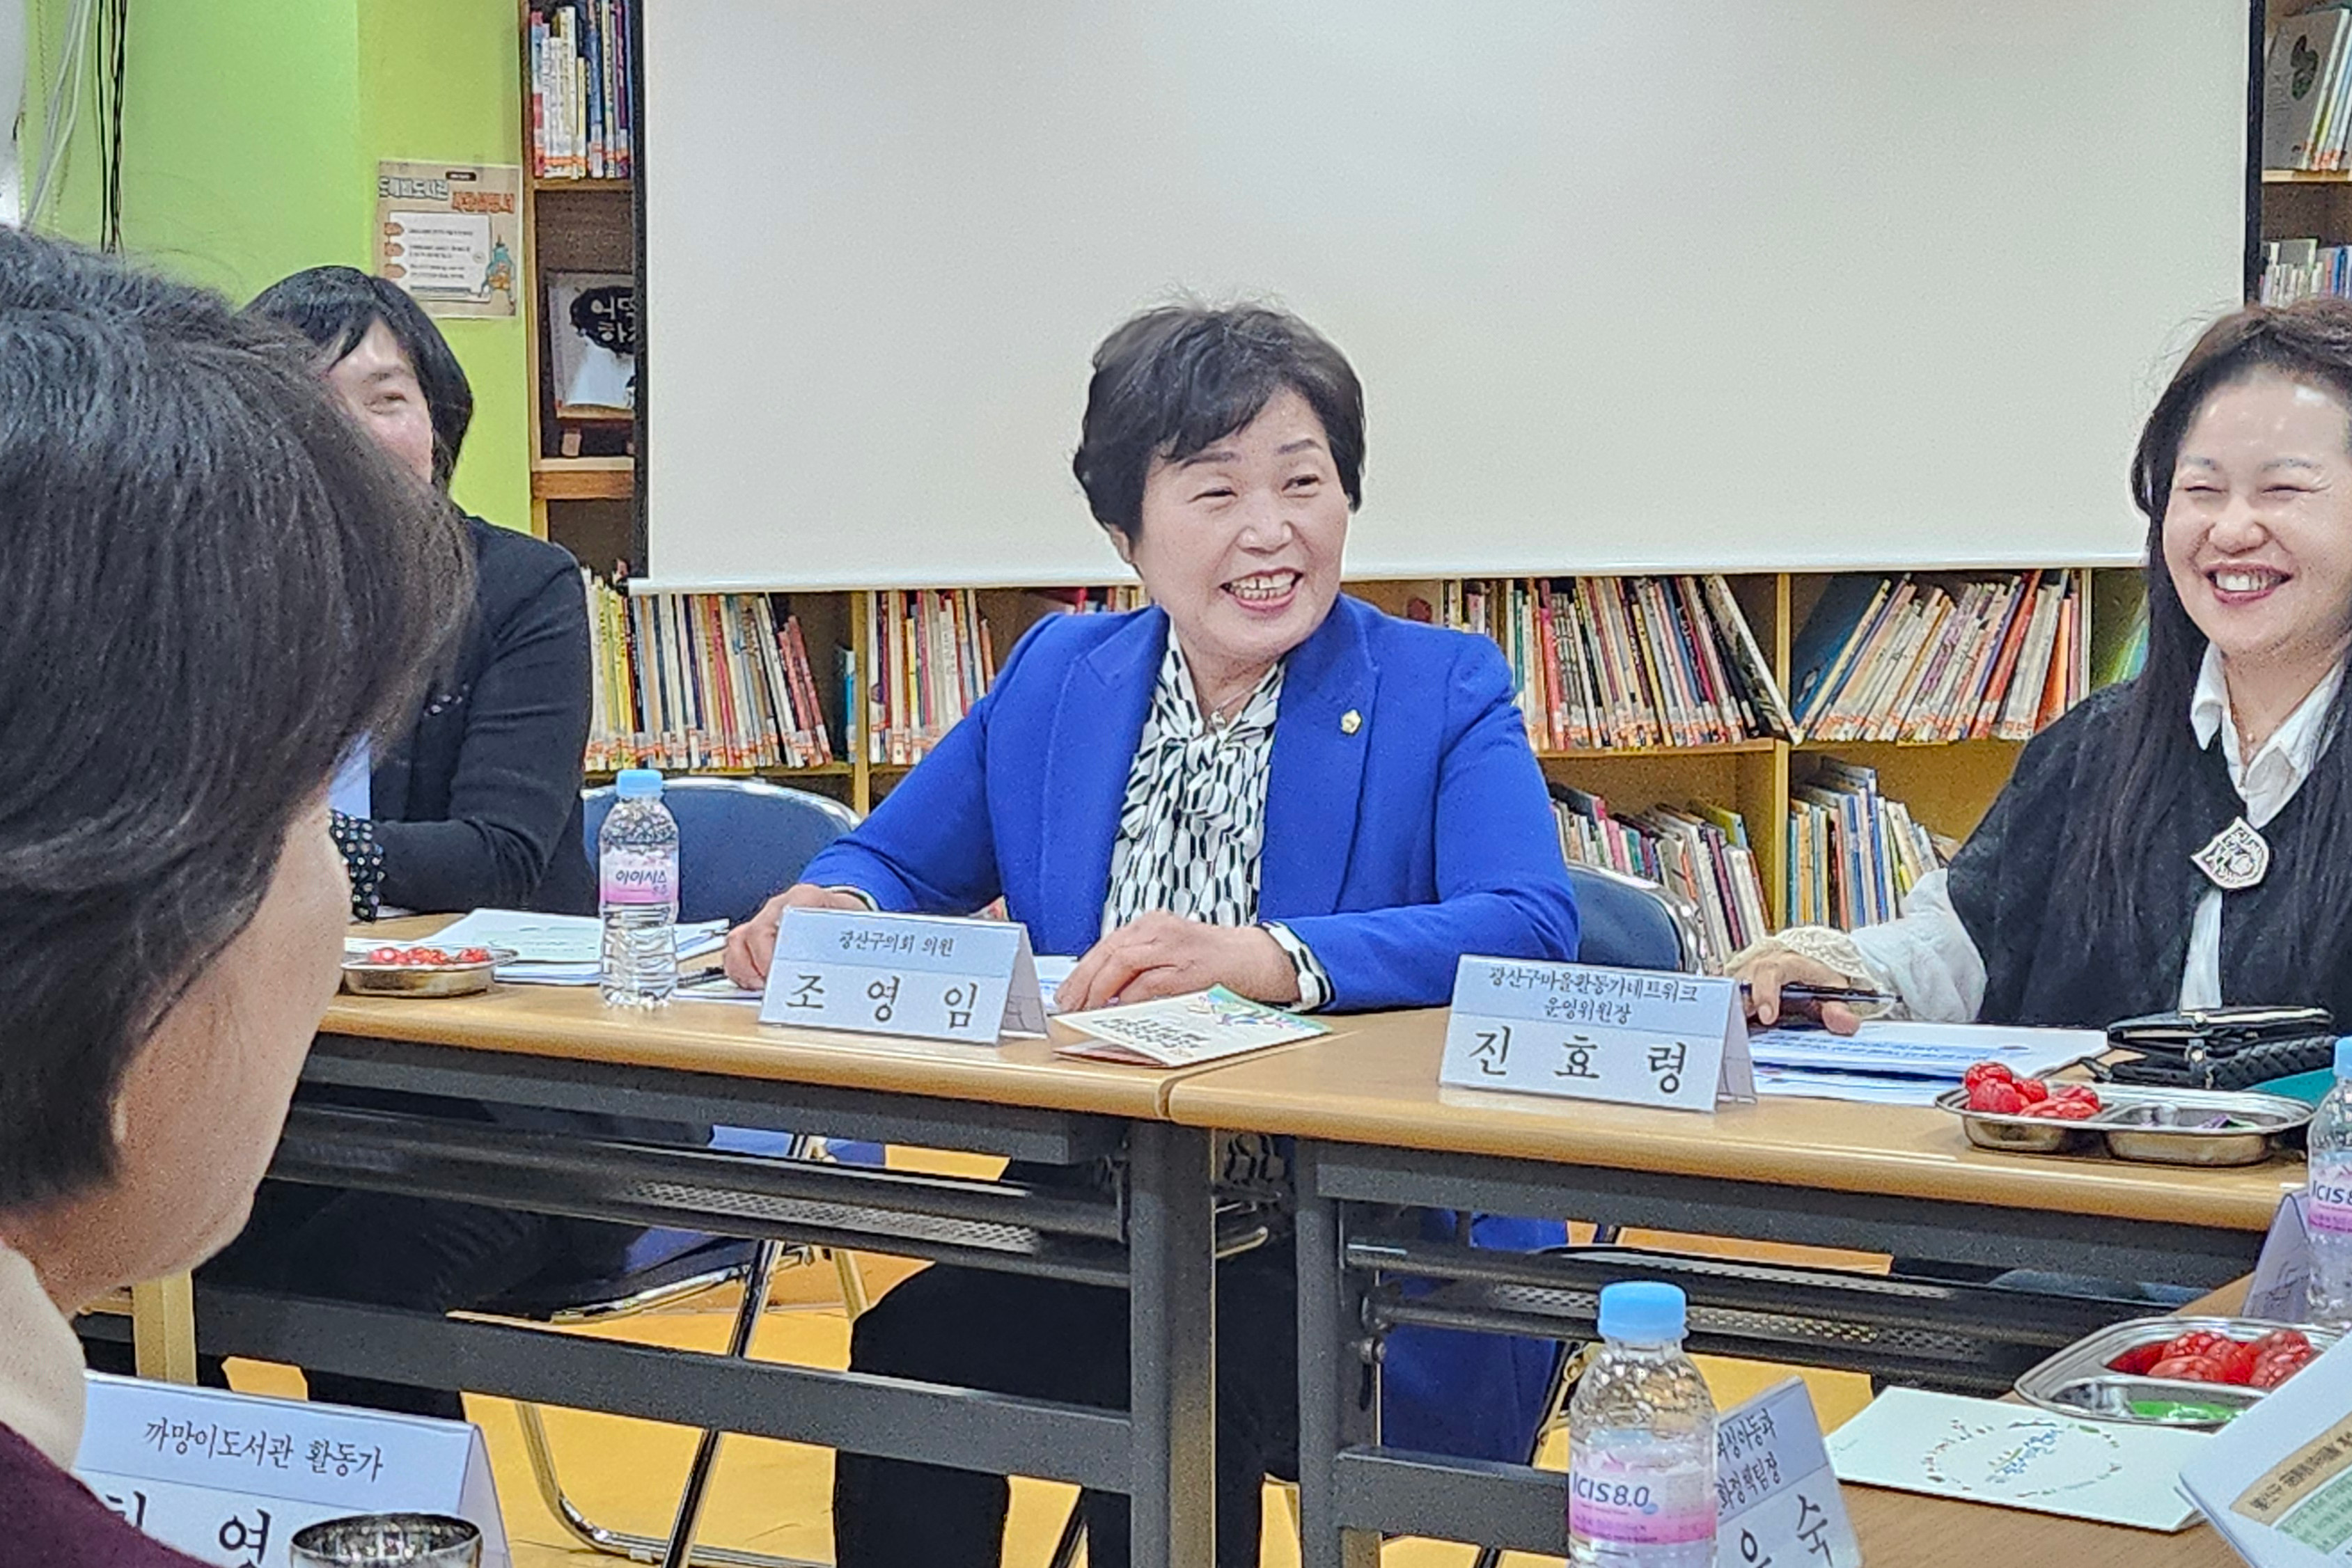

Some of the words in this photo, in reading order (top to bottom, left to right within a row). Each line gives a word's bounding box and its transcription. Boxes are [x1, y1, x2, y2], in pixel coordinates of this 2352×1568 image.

[839, 930, 915, 954] 광산구의회
[921, 936, 953, 957] 의원
[785, 973, 825, 1010] 조
[868, 975, 900, 1023] 영
[944, 982, 978, 1029] 임
[1544, 996, 1633, 1025] 운영위원장
[1469, 1026, 1511, 1076] 진
[1554, 1035, 1600, 1079] 효
[1647, 1042, 1686, 1093] 령
[144, 1417, 294, 1469] 까망이도서관
[305, 1438, 384, 1482] 활동가
[1714, 1450, 1781, 1516] 화정책팀장
